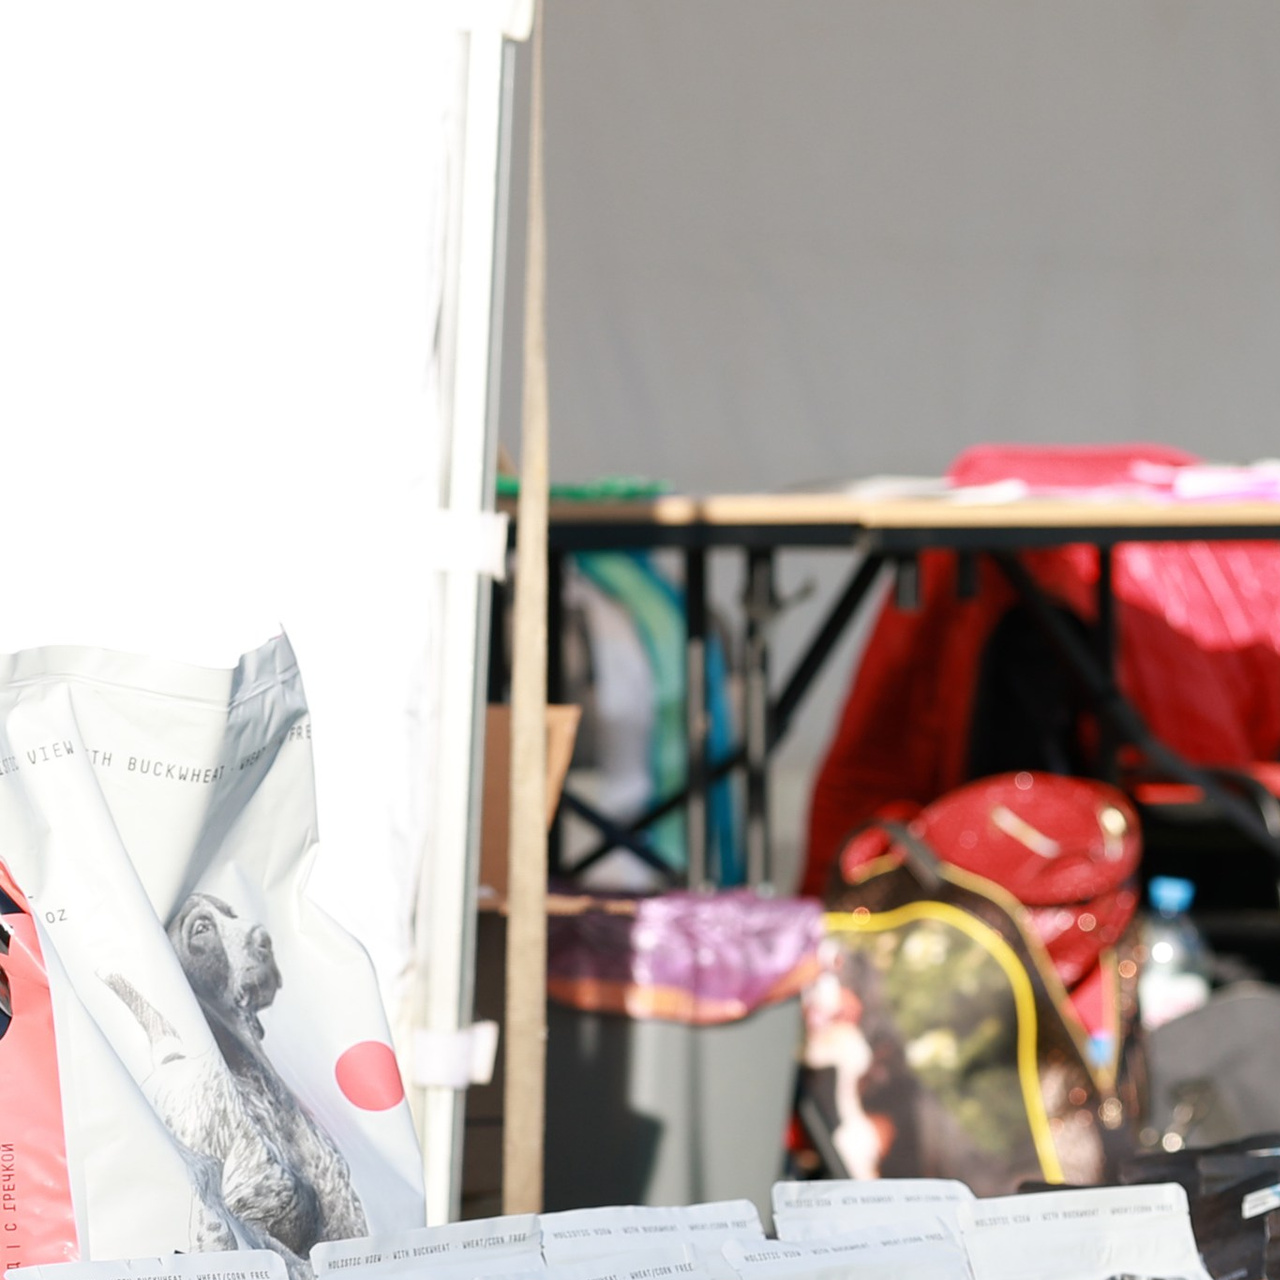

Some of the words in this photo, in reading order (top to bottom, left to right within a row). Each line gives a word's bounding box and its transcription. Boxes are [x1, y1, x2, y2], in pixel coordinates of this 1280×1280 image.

[27, 740, 75, 765] VIEW
[127, 756, 226, 784] BUCKWHEAT
[45, 909, 68, 924] OZ
[676, 1261, 694, 1273] FREE
[250, 1271, 271, 1280] FREE
